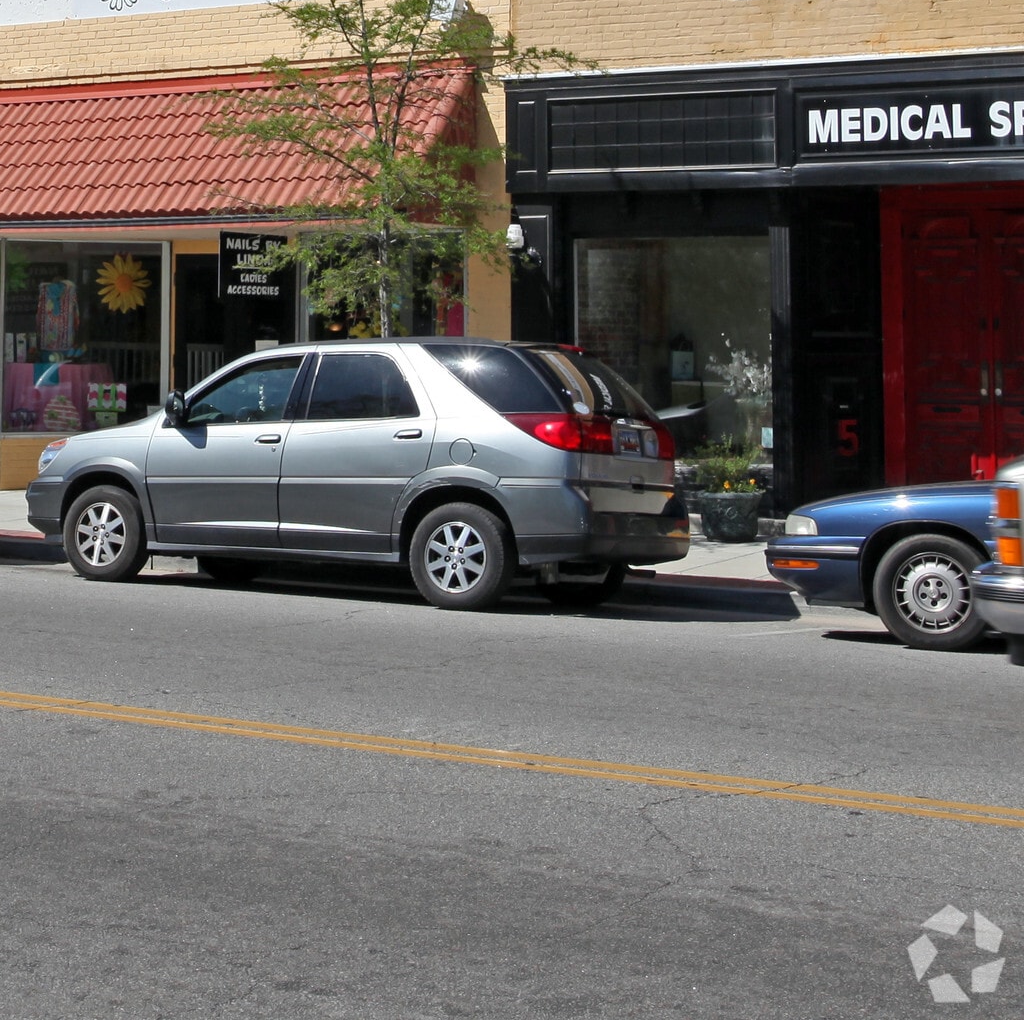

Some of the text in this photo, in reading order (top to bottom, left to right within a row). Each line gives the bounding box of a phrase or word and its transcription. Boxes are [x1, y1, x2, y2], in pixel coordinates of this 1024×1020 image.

[808, 104, 972, 143] MEDICAL
[226, 237, 260, 250] NAILS
[240, 273, 268, 284] LADIES
[227, 284, 280, 296] ACCESSORIES
[839, 419, 859, 456] 5
